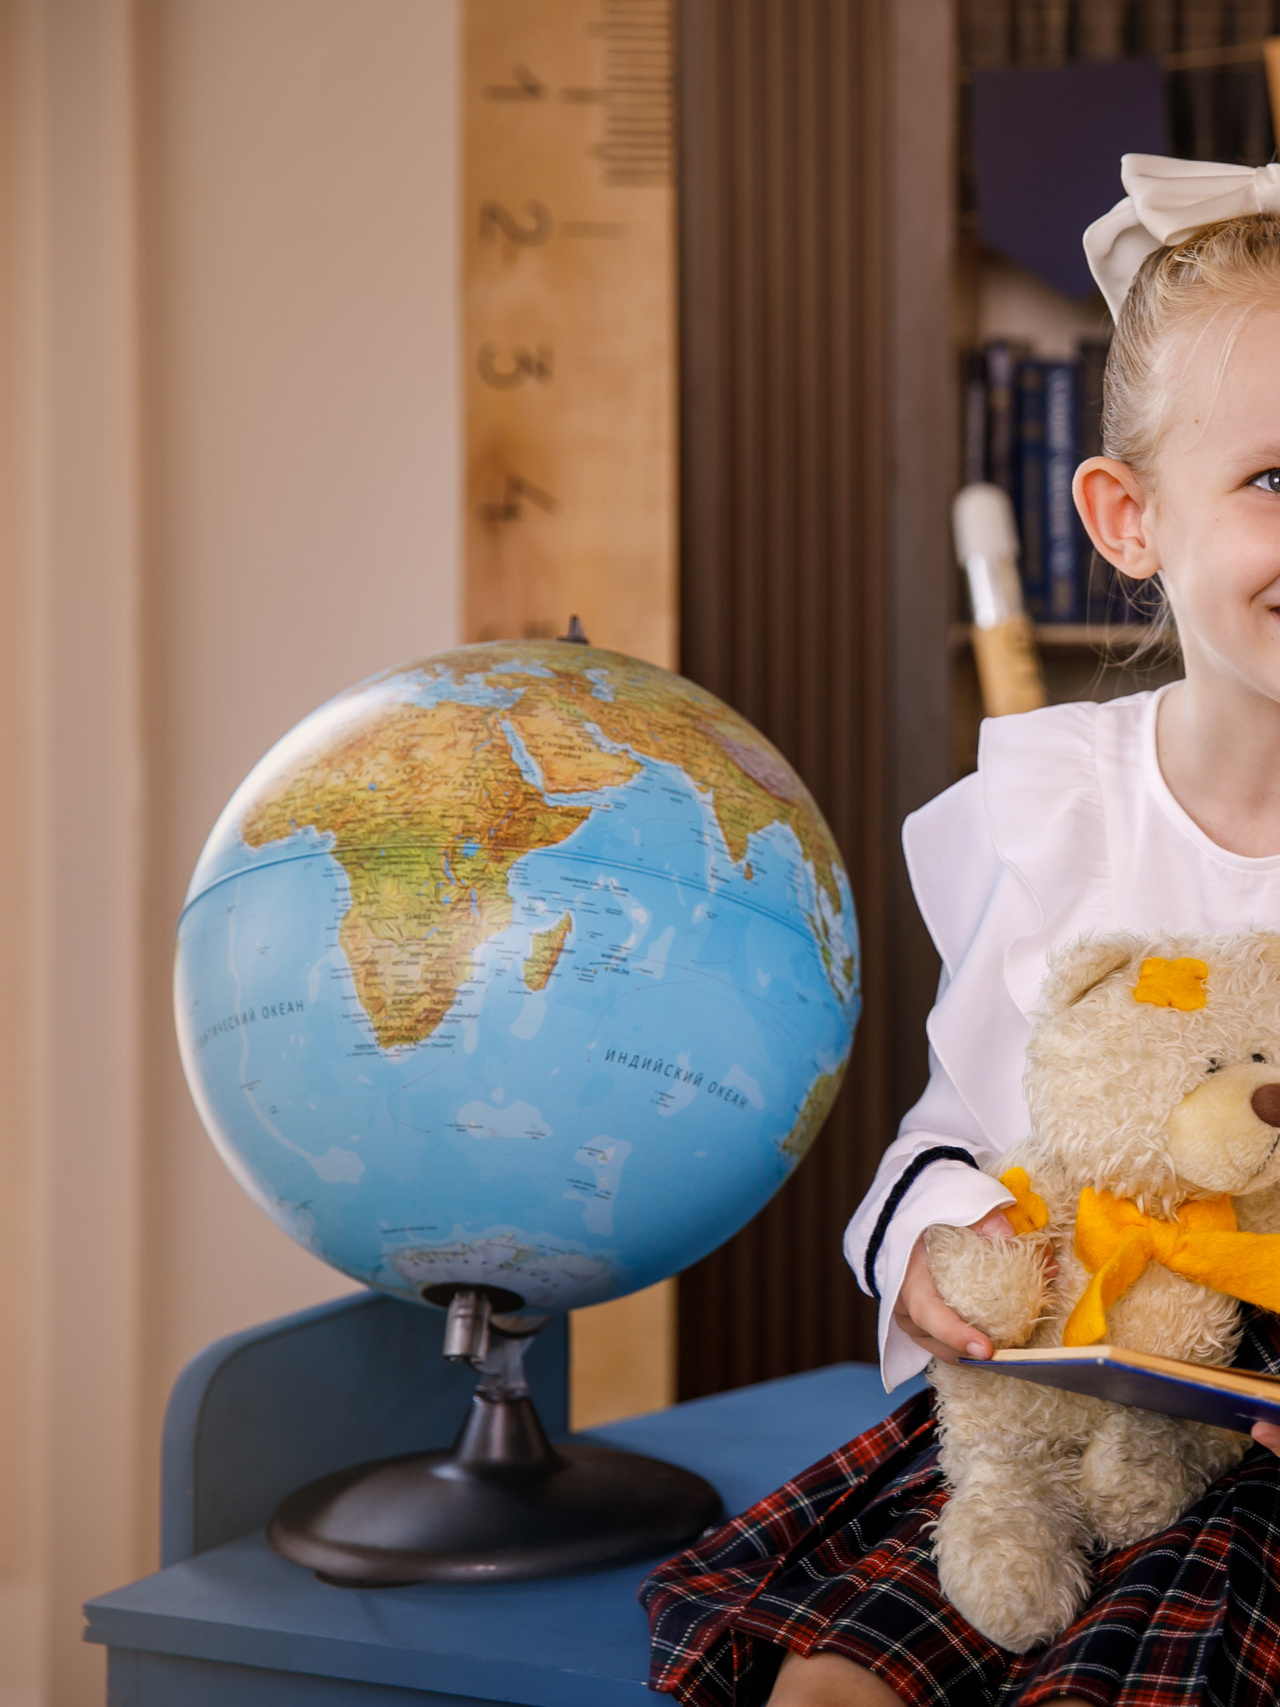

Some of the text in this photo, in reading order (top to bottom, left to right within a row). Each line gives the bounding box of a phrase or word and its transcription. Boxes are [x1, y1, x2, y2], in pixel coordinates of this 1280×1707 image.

[482, 63, 548, 104] 1
[477, 200, 554, 249] 2
[476, 340, 555, 392] 3
[261, 999, 305, 1020] ОКЕАН
[604, 1049, 748, 1109] ИНДИЙСКИЙ ОКЕАН
